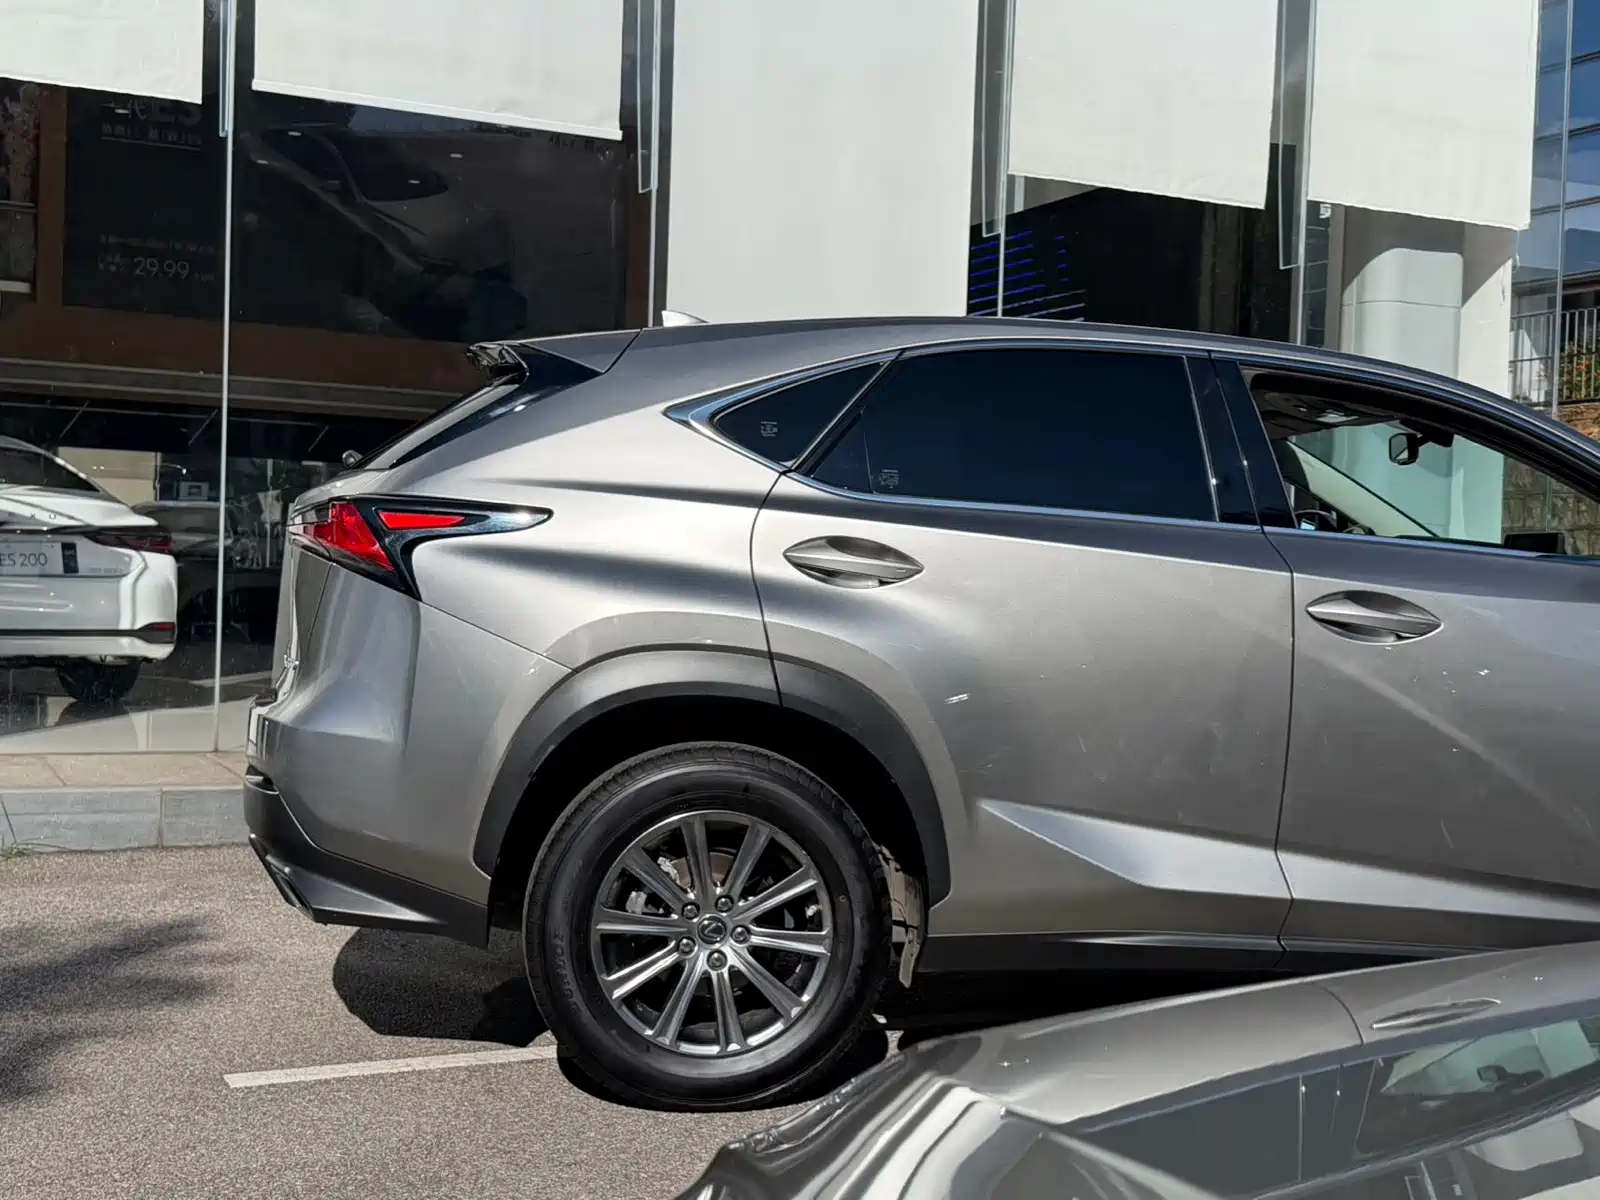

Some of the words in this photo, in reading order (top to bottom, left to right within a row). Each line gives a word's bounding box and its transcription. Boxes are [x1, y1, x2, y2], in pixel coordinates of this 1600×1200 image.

[132, 256, 190, 280] 29.99
[0, 552, 16, 567] ES
[19, 552, 48, 567] 200
